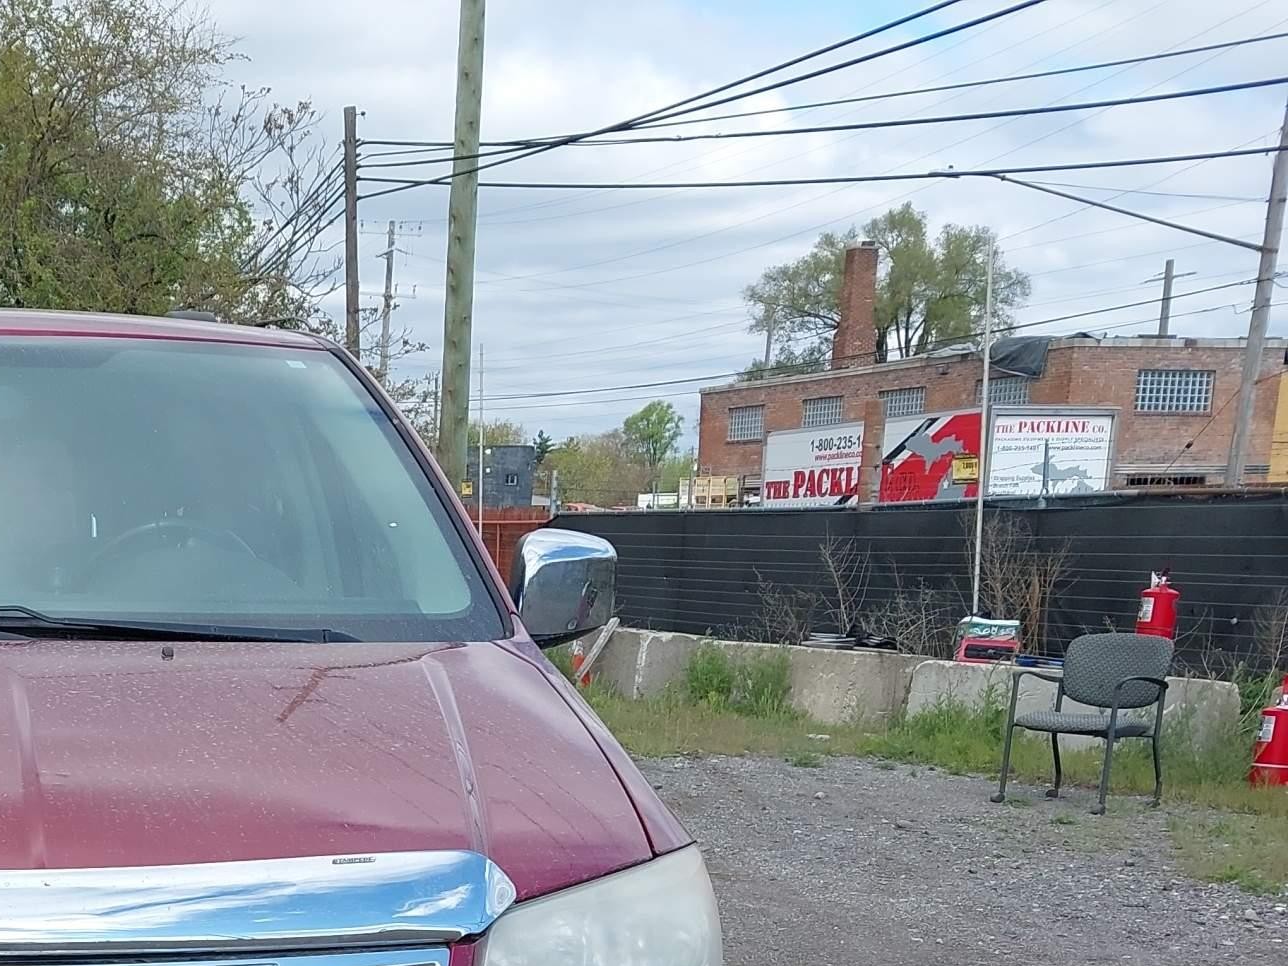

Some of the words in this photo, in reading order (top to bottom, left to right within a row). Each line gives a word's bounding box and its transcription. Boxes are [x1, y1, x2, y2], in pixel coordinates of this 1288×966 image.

[996, 424, 1015, 434] THE
[1017, 420, 1090, 434] PACKLINE
[1092, 424, 1107, 433] CO.
[810, 434, 862, 452] 1-800-235-1
[815, 451, 863, 463] www.packlineco.co
[766, 479, 791, 500] THE
